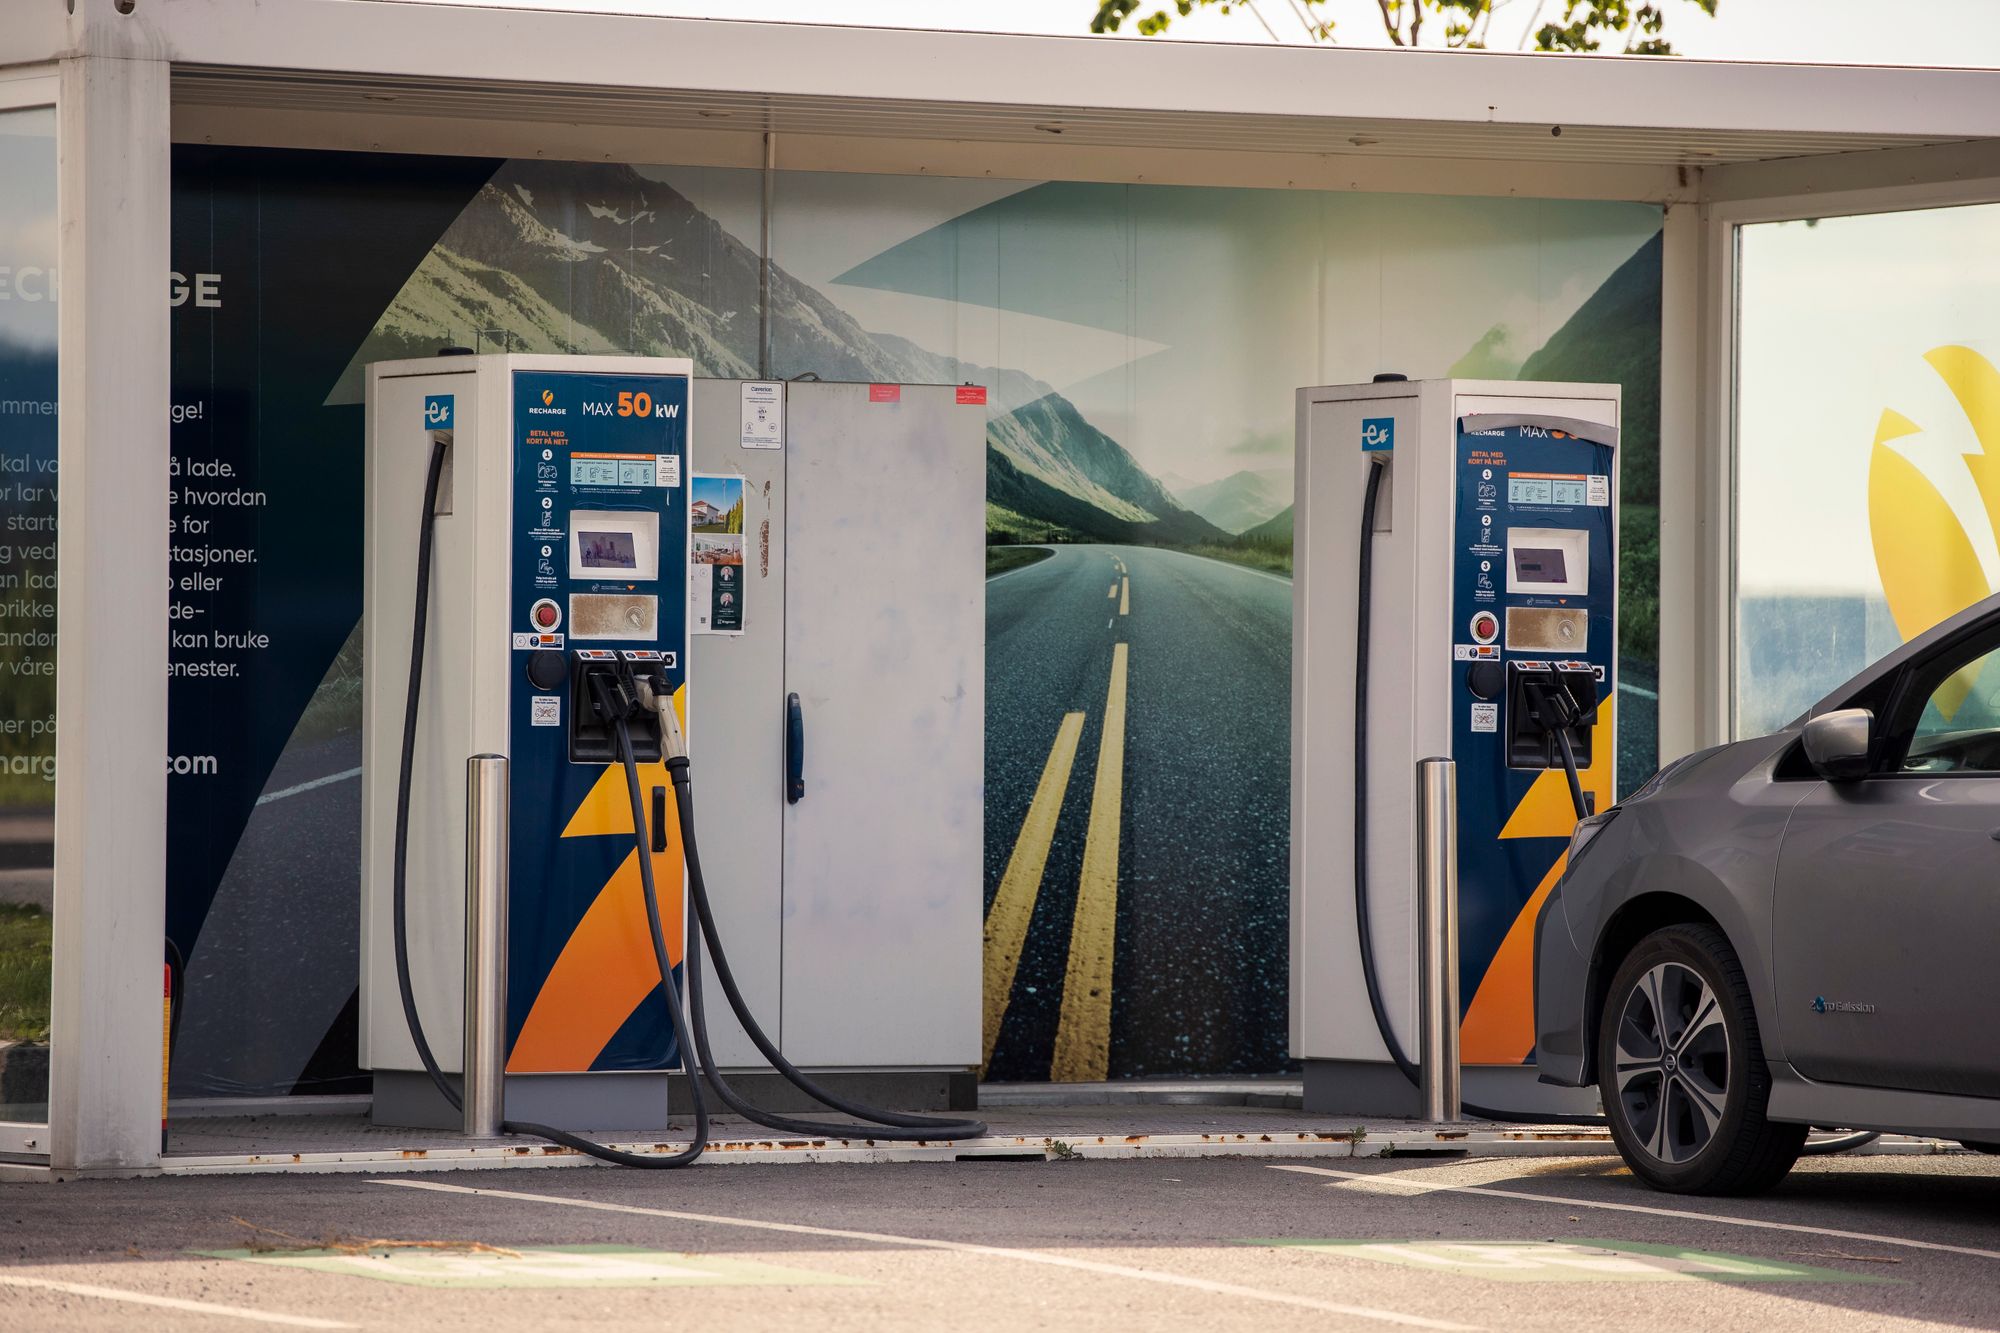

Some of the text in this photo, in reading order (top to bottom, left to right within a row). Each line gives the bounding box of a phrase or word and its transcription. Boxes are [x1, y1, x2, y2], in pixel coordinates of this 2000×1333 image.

[529, 407, 567, 415] RECHARGE
[582, 391, 680, 418] MAX 50 kW
[544, 437, 553, 445] PÅ
[1520, 425, 1549, 439] MAX
[187, 456, 237, 478] lade.
[184, 486, 267, 506] hvordan
[182, 514, 210, 534] for
[180, 571, 223, 592] eller
[172, 629, 208, 648] kan
[214, 629, 270, 649] bruke
[10, 656, 55, 676] våre
